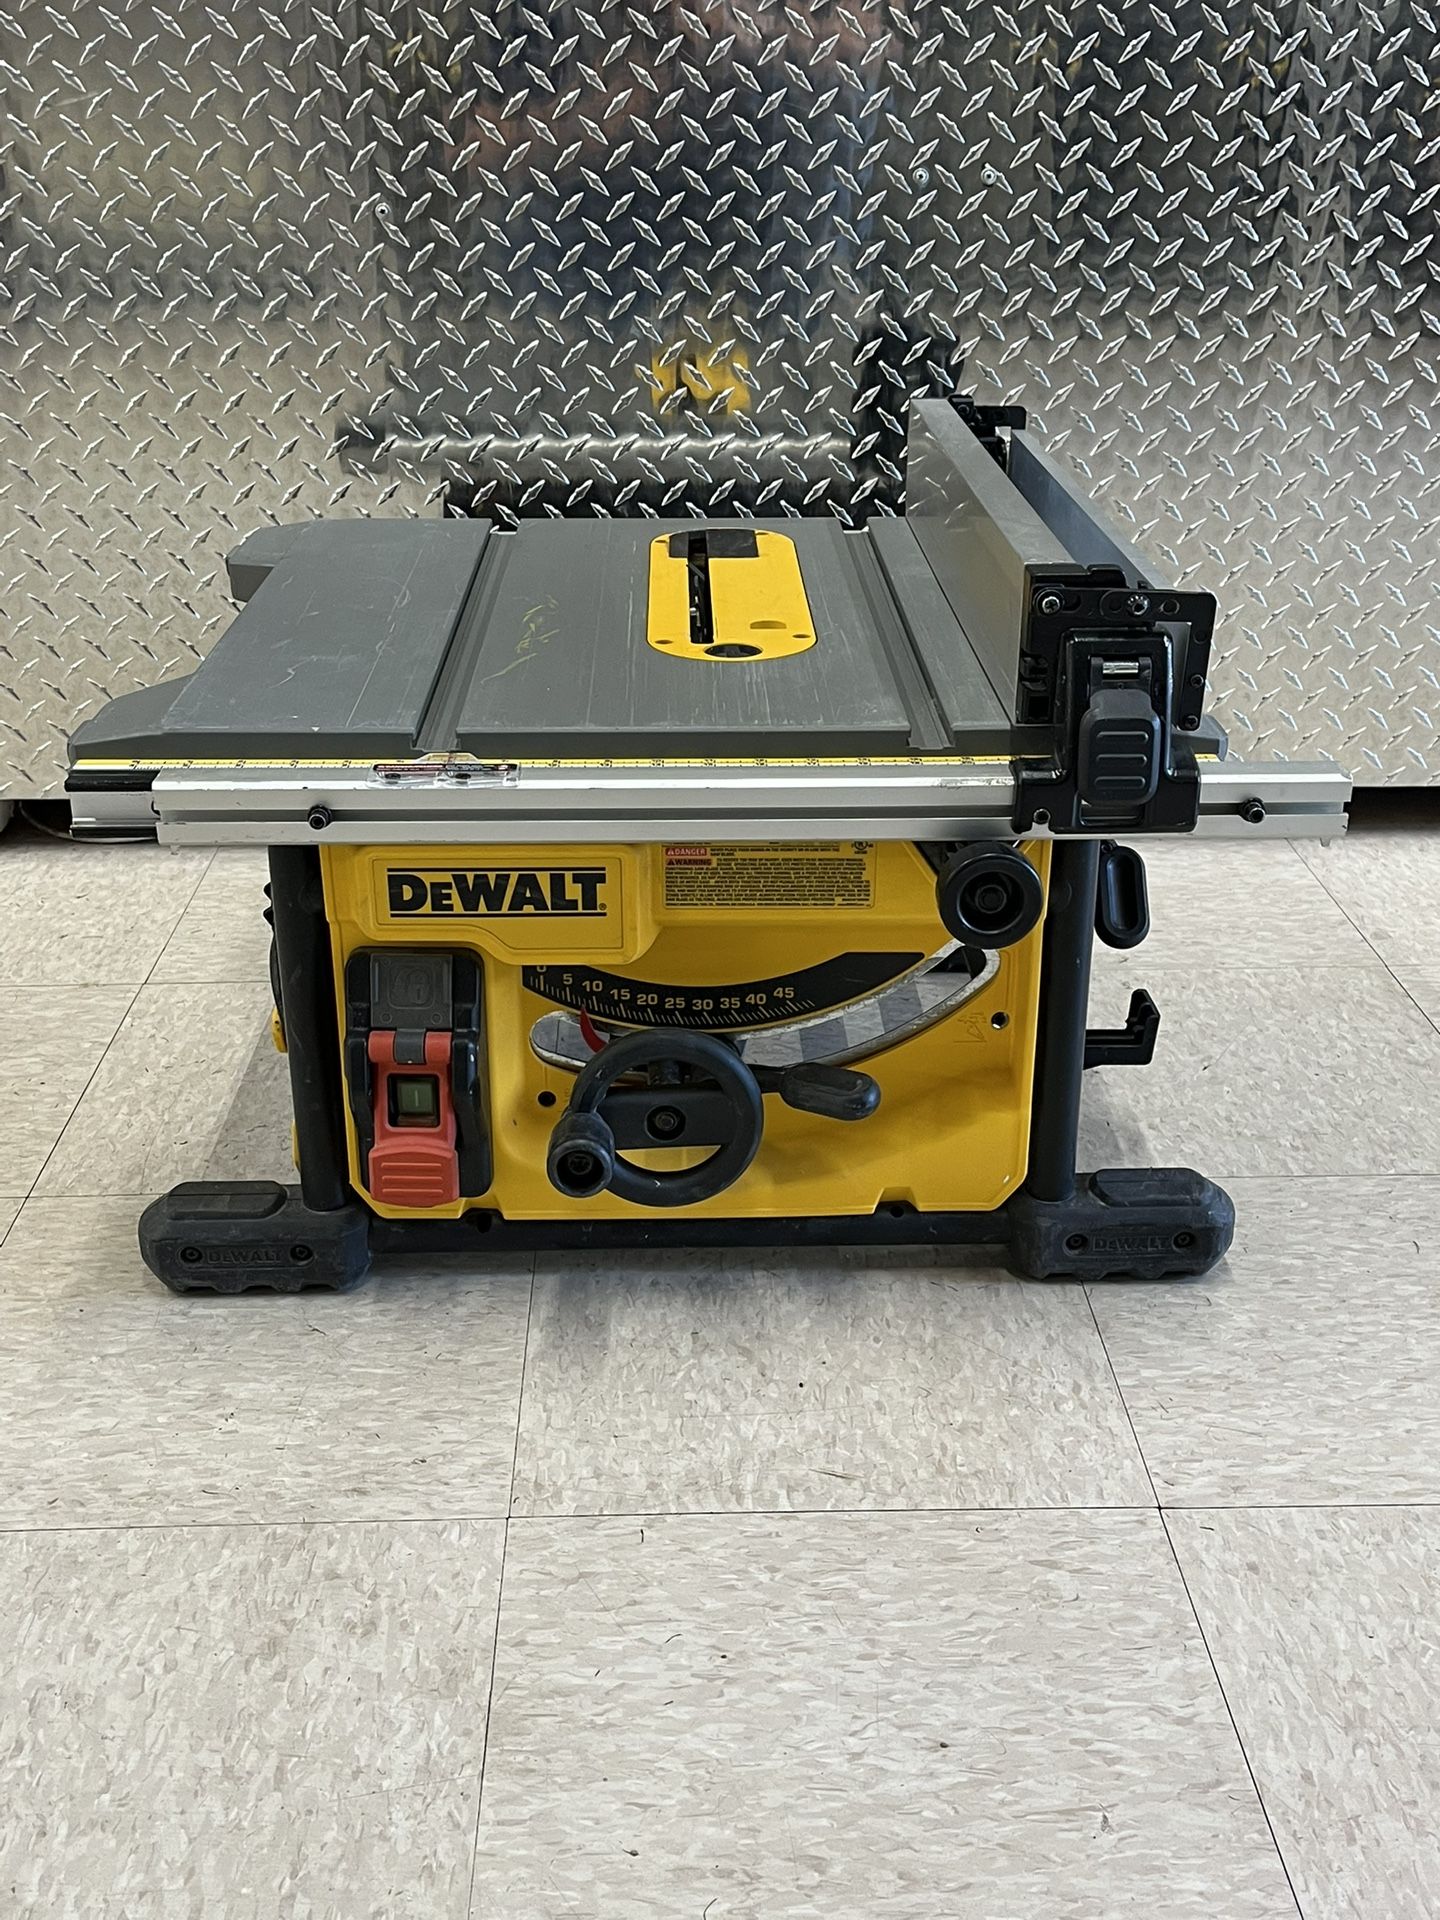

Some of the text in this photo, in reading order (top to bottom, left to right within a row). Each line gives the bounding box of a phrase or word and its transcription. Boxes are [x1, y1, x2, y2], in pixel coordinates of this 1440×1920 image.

[563, 974, 573, 985] 5
[582, 981, 603, 992] 10
[610, 989, 631, 1000] 15
[636, 994, 658, 1005] 20
[664, 998, 686, 1009] 25
[692, 1000, 714, 1010] 30
[719, 998, 741, 1009] 35
[745, 993, 767, 1005] 40
[773, 987, 795, 998] 45
